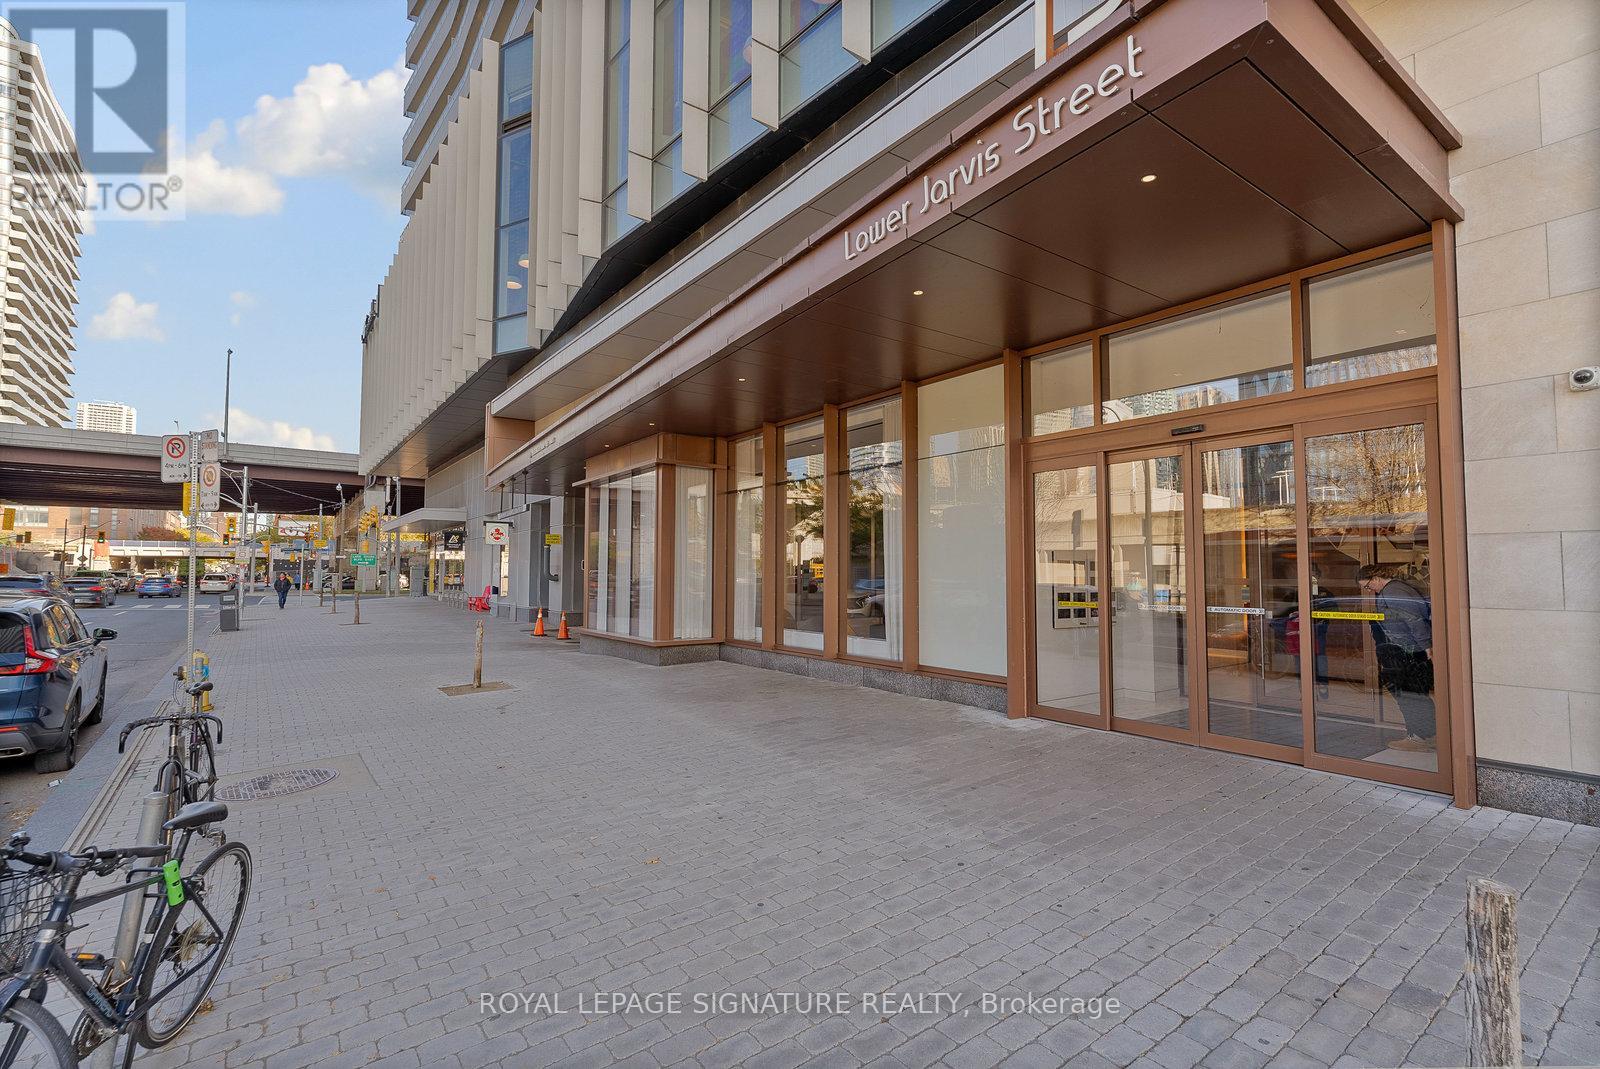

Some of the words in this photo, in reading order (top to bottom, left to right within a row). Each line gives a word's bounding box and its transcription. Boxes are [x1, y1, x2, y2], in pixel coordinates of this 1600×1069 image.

[843, 200, 911, 260] Lower
[920, 139, 1001, 214] Jarvis
[1012, 34, 1144, 154] Street
